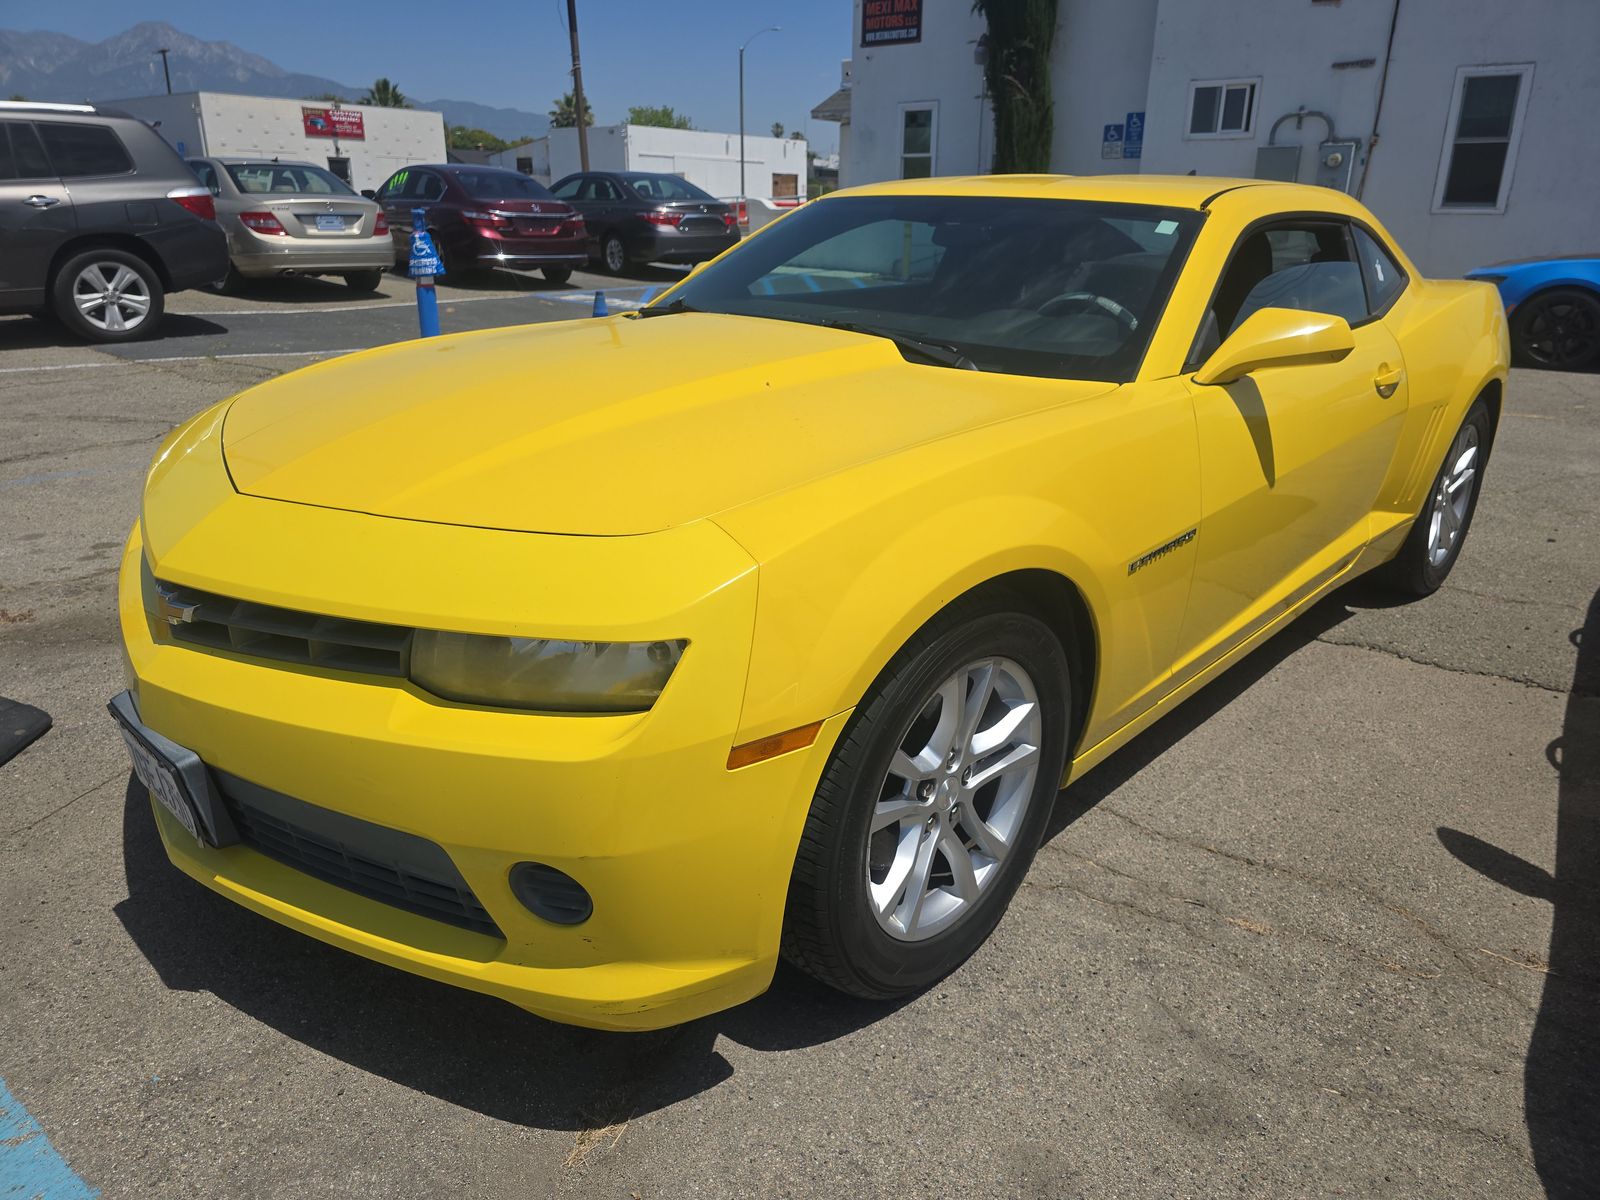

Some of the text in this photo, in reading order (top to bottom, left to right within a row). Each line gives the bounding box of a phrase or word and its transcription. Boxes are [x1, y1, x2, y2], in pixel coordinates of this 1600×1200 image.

[866, 0, 917, 15] MEXI MAX
[865, 16, 918, 29] MOTORS LLC
